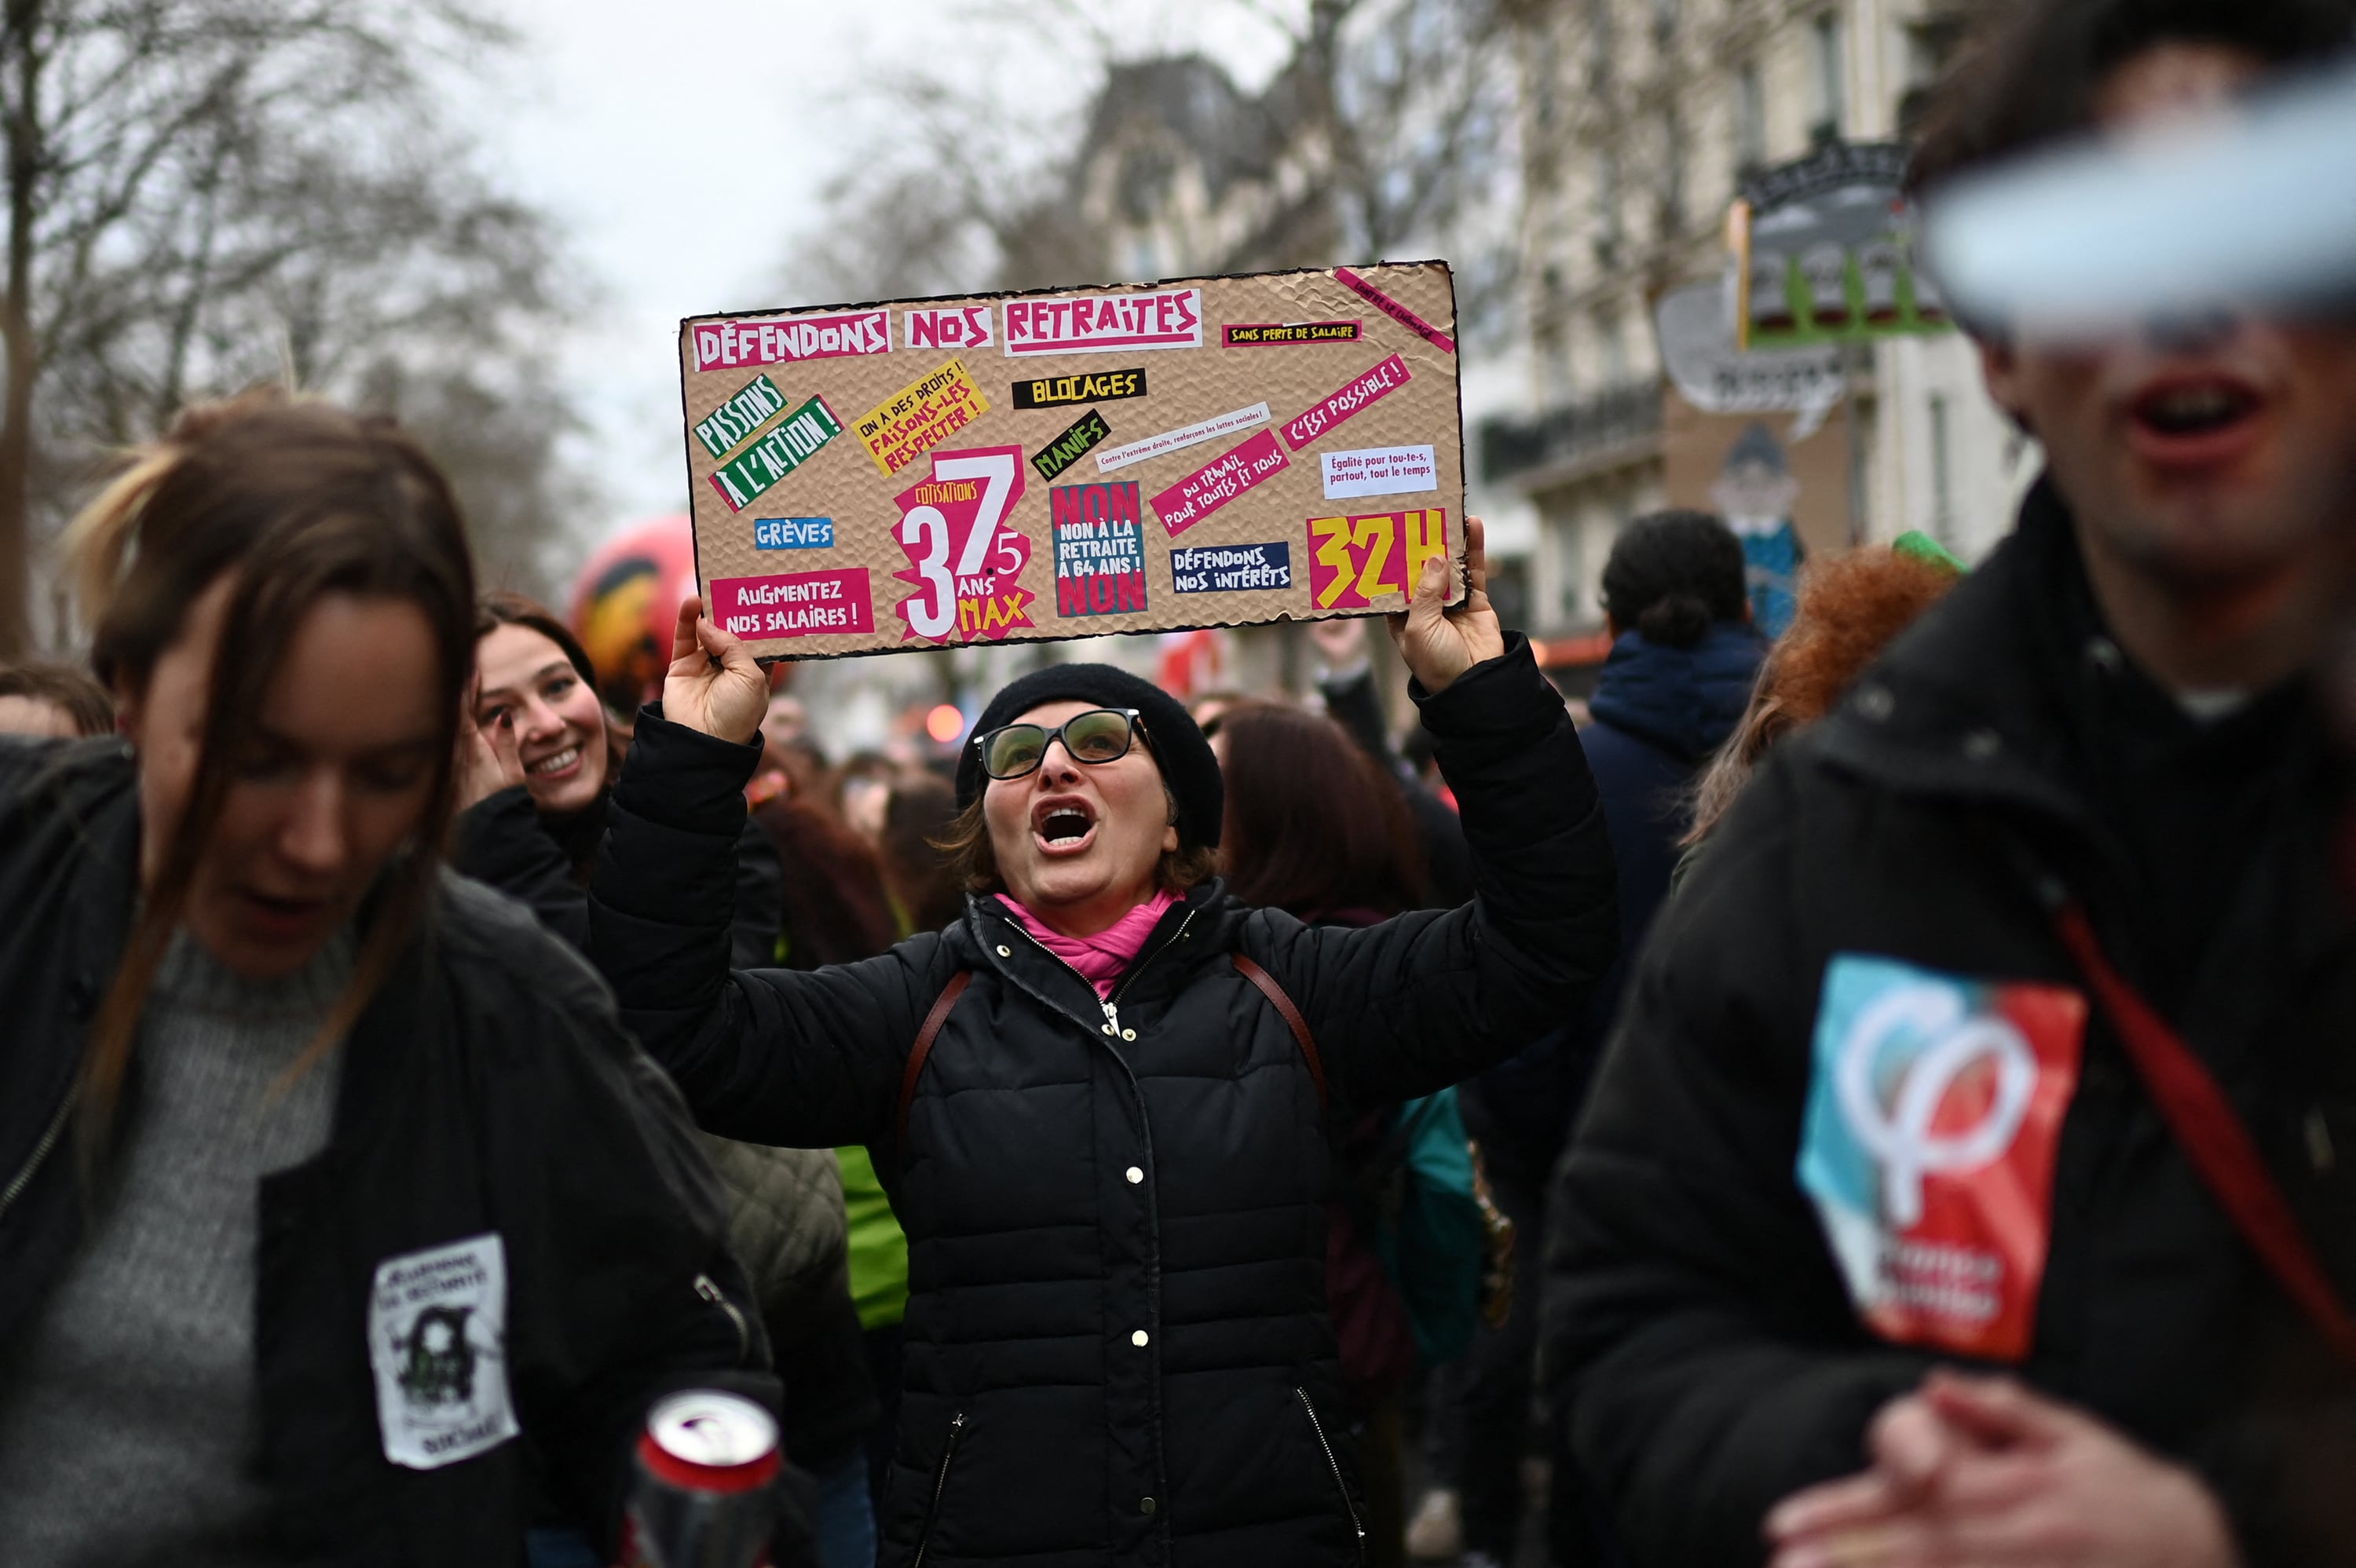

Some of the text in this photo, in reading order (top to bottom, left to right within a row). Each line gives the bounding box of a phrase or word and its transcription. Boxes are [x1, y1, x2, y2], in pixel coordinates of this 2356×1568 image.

[1355, 282, 1385, 306] CONTRE
[1385, 302, 1396, 314] LE
[700, 313, 886, 364] DÉFENDONS
[913, 307, 988, 348] NOS
[1232, 327, 1259, 341] SANS
[1263, 327, 1293, 341] PERTE
[1297, 327, 1308, 339] DE
[1032, 374, 1137, 403] BLOCAGES
[696, 375, 783, 455] PASSONS
[860, 419, 879, 437] ON
[881, 411, 891, 425] A
[893, 395, 913, 416] DES
[1291, 409, 1327, 440] C'EST
[885, 408, 968, 472] RESPECTER
[1101, 455, 1121, 465] Contre
[1153, 440, 1173, 450] droite,
[1174, 430, 1205, 443] renforçons
[1216, 420, 1234, 429] luttes
[1330, 465, 1430, 485] partout, tout le temps
[1332, 455, 1362, 470] Égalité
[1365, 455, 1385, 468] pour
[716, 471, 748, 508] À
[1165, 449, 1282, 528] POUR TOUTES ET TOUS
[1183, 481, 1199, 498] DU
[1052, 483, 1139, 530] NON
[757, 519, 832, 546] GRÈVES
[1061, 517, 1134, 540] NON À LA
[1059, 538, 1137, 559] RETRAITE
[1175, 546, 1265, 571] DÉFENDONS
[1059, 558, 1070, 578] À
[1074, 560, 1095, 576] 64
[1098, 557, 1131, 574] ANS
[1176, 573, 1207, 590] NOS
[737, 580, 842, 605] AUGMENTEZ
[957, 576, 996, 597] ANS
[1058, 568, 1146, 615] NON
[726, 615, 759, 634] NOS
[958, 592, 1024, 632] MAX
